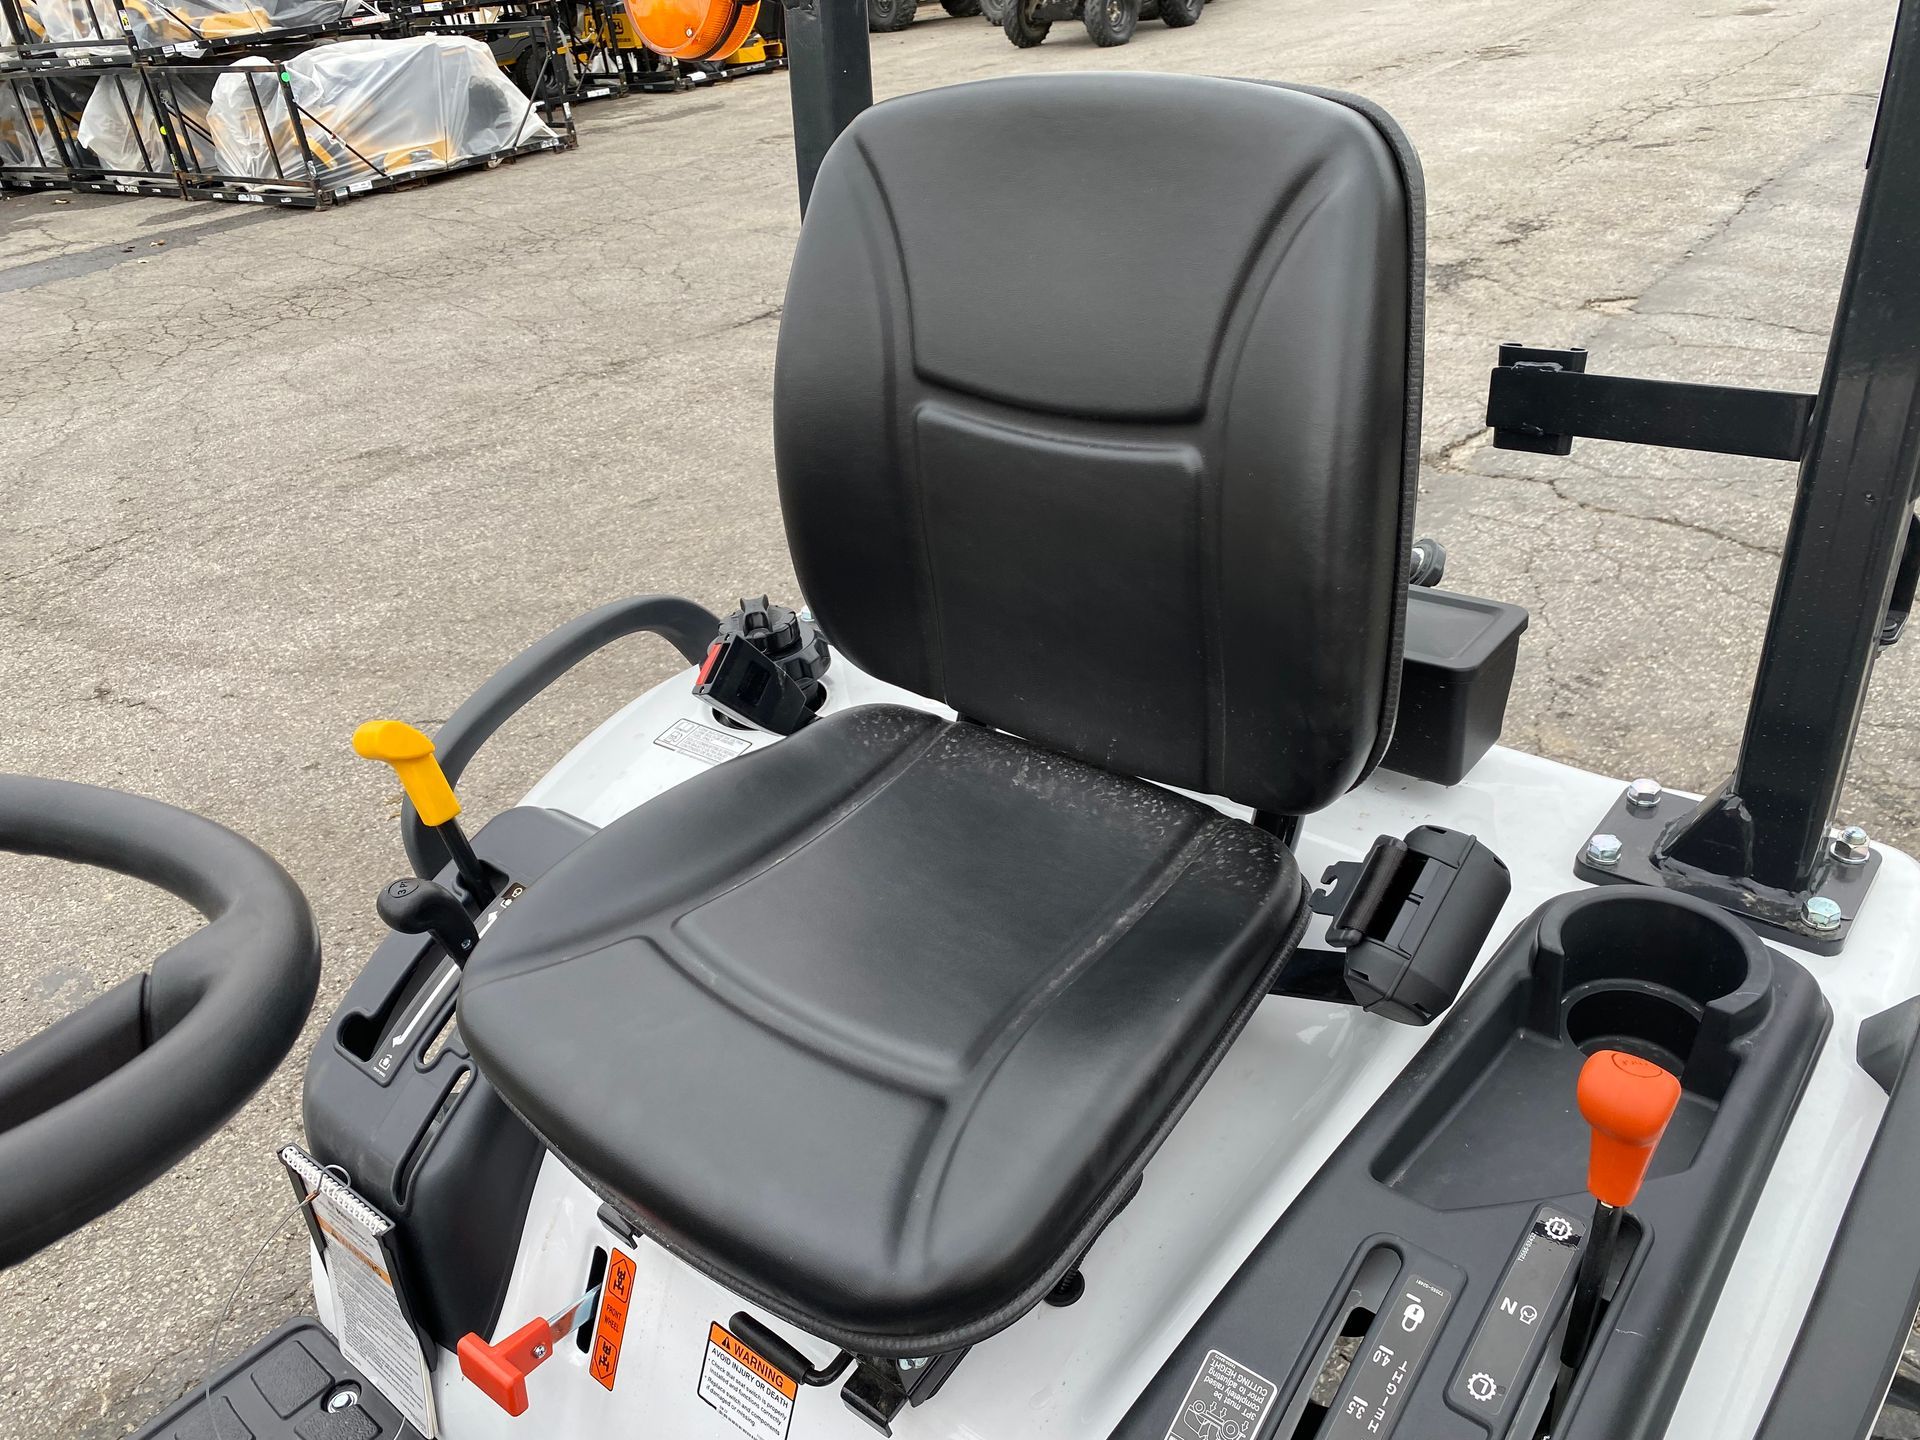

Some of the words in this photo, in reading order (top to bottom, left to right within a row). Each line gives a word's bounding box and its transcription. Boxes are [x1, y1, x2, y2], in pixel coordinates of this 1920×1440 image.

[1551, 1222, 1566, 1236] H
[606, 1303, 622, 1320] FRONT
[1500, 1296, 1518, 1316] N
[604, 1314, 620, 1334] WHEEL
[734, 1342, 784, 1388] WARNING
[1210, 1358, 1238, 1379] HEIGHT.
[1372, 1350, 1391, 1367] 4.0
[711, 1348, 731, 1366] AVOID
[732, 1362, 754, 1383] INJURY
[755, 1380, 766, 1392] OR
[766, 1387, 789, 1408] DEATH
[1204, 1376, 1225, 1390] raised
[1208, 1366, 1238, 1388] adjusting
[1236, 1374, 1268, 1397] CUTTING
[710, 1368, 729, 1386] installed
[729, 1382, 738, 1392] and
[738, 1388, 760, 1409] functions
[710, 1387, 731, 1406] damaged
[711, 1359, 726, 1373] Check
[726, 1370, 736, 1380] that
[736, 1378, 746, 1387] seat
[746, 1384, 761, 1400] switch
[766, 1402, 787, 1420] properly
[1213, 1390, 1223, 1401] be
[1238, 1386, 1247, 1395] to
[1250, 1393, 1265, 1404] prior
[1367, 1360, 1408, 1434] HEIGHT
[708, 1376, 726, 1394] Replace
[726, 1390, 742, 1406] switch
[742, 1402, 750, 1413] and
[750, 1408, 780, 1436] components
[1224, 1386, 1260, 1412] completely
[1224, 1400, 1242, 1410] must
[1241, 1408, 1257, 1421] 3PT
[1346, 1400, 1366, 1420] 3.5
